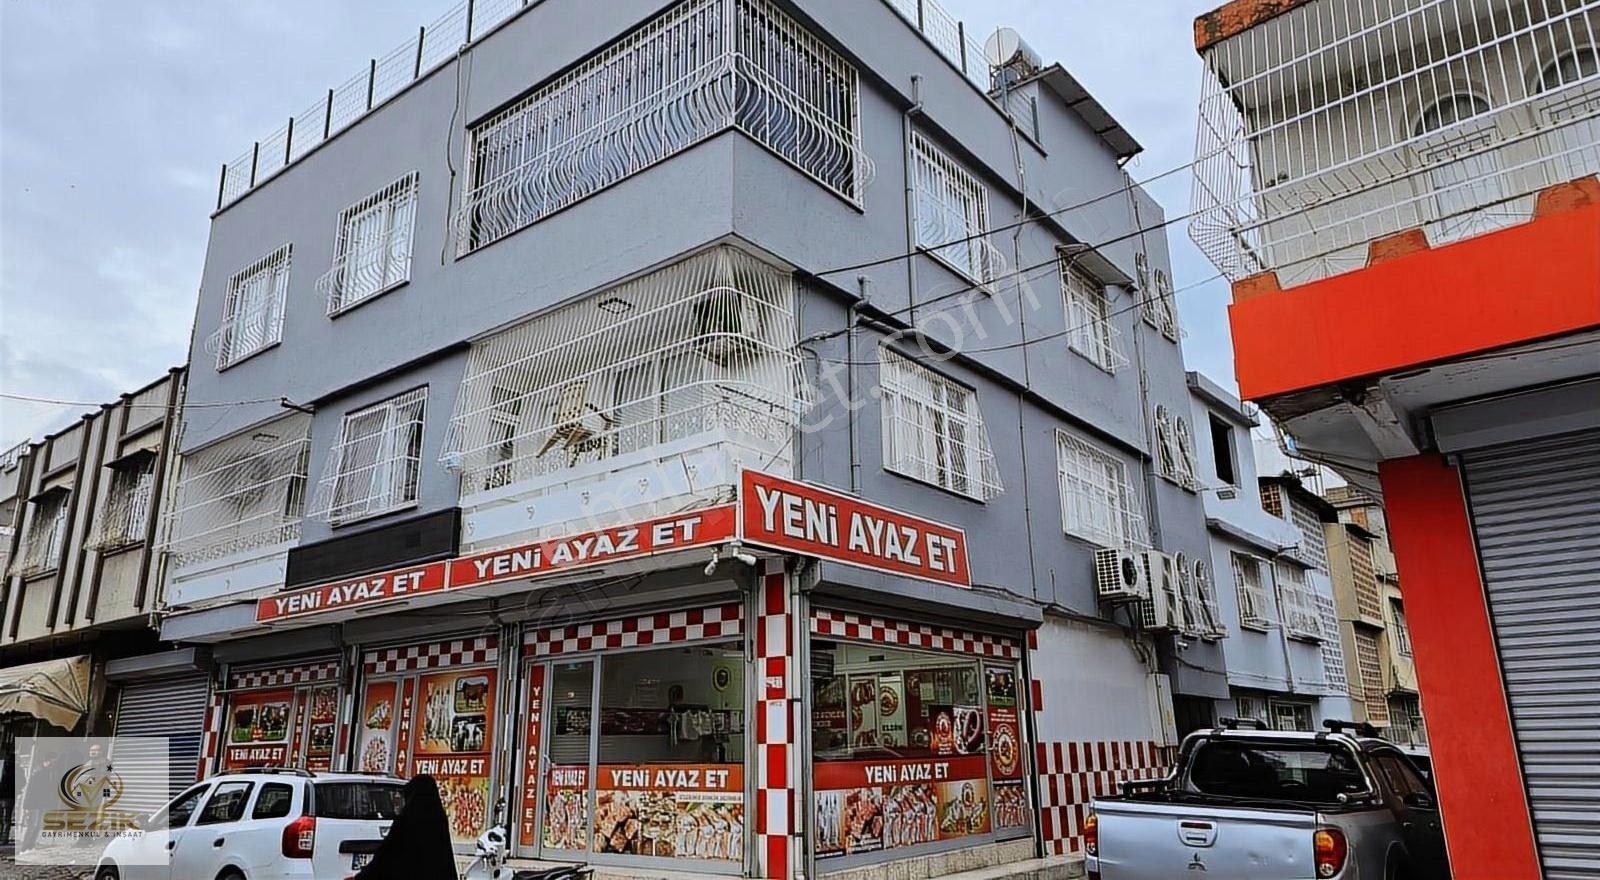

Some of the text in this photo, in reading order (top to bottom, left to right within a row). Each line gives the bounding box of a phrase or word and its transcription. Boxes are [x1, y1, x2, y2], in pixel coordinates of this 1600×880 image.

[550, 528, 639, 565] AYAZ
[651, 516, 702, 547] ET
[848, 511, 922, 566] AYAZ
[925, 531, 958, 574] ET
[327, 578, 386, 605] AYAZ
[392, 570, 425, 593] ET
[271, 747, 284, 760] ET
[440, 759, 468, 775] AYAZ
[470, 759, 485, 774] ET
[526, 745, 537, 799] AYAZ
[654, 770, 700, 788] AYAZ
[705, 770, 729, 788] ET
[900, 764, 932, 782] AYAZ
[934, 763, 949, 779] ET
[524, 808, 534, 833] ET
